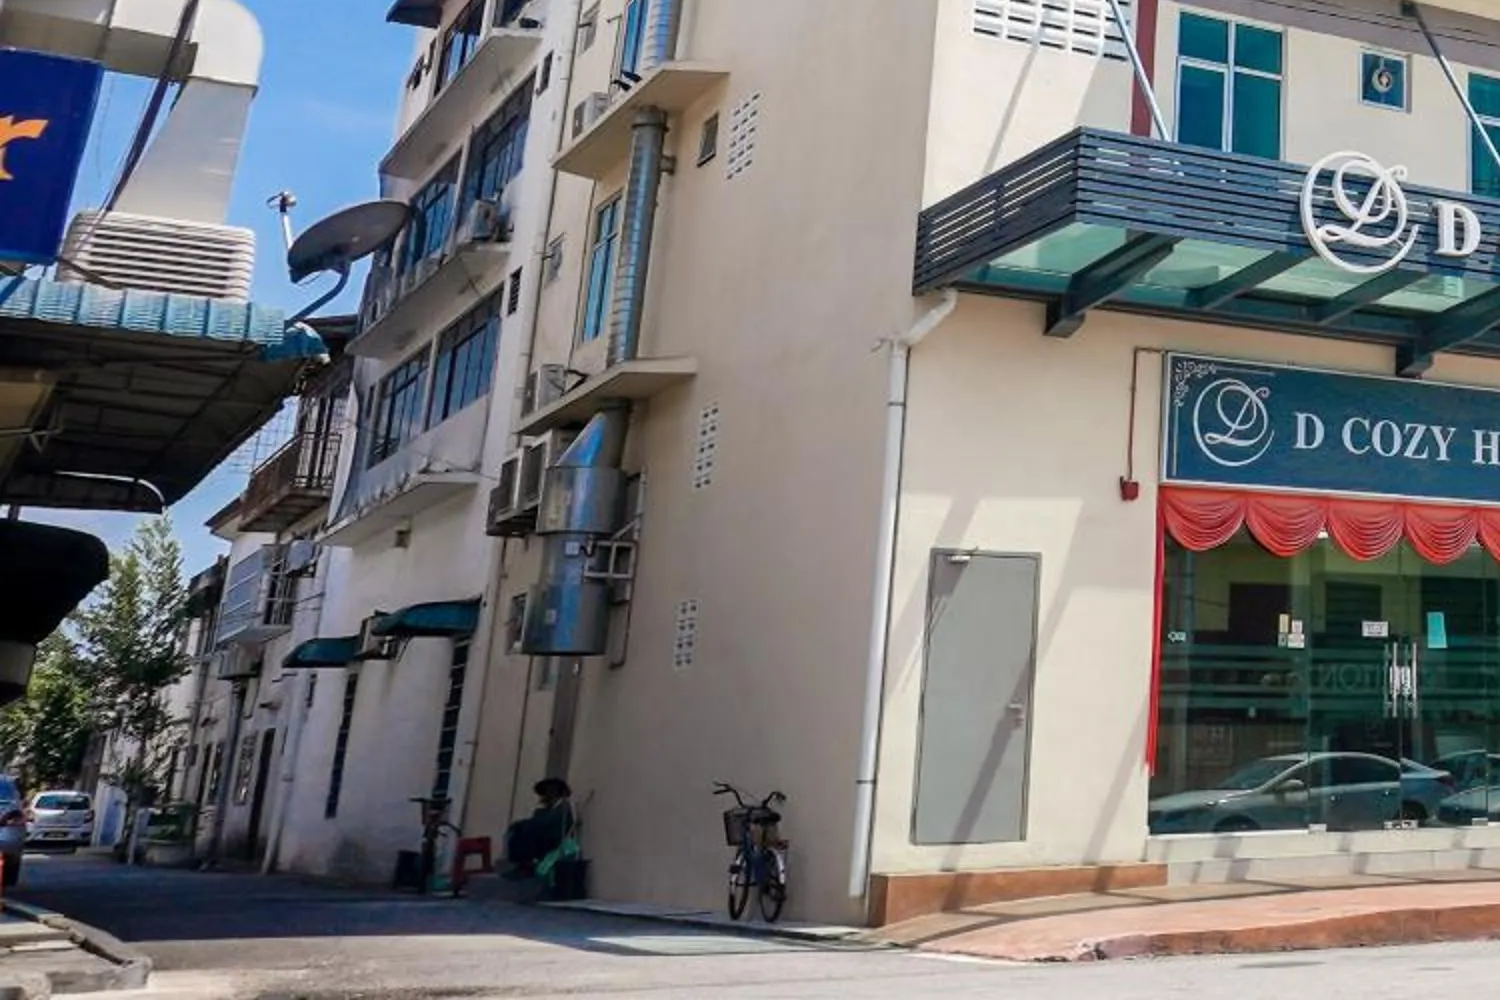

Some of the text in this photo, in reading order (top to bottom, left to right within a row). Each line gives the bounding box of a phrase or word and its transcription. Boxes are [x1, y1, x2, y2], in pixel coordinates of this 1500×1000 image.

[1431, 200, 1482, 257] D
[1292, 411, 1326, 450] D
[1341, 417, 1456, 462] COZY
